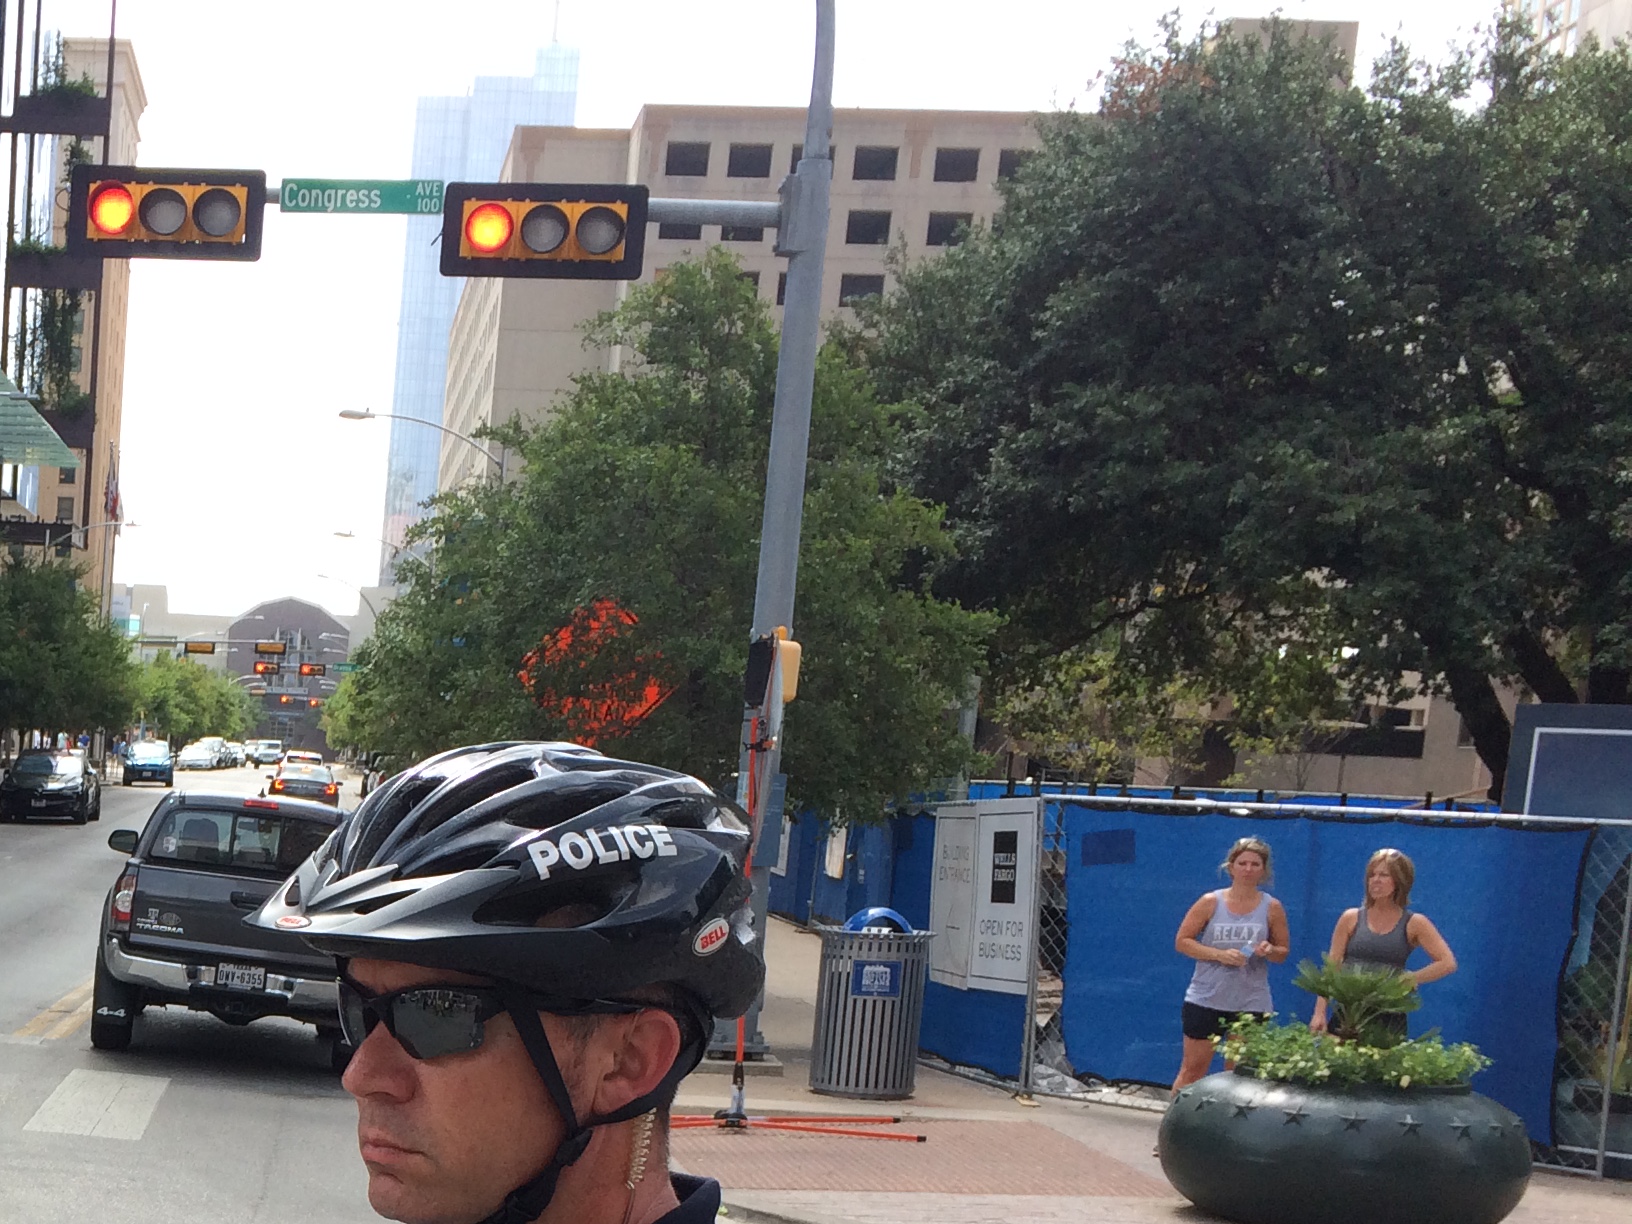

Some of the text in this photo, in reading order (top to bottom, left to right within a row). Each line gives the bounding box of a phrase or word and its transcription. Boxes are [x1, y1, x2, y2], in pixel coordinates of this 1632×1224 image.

[415, 181, 440, 196] AVE
[285, 183, 381, 212] Congress
[418, 198, 439, 211] 100
[526, 825, 678, 880] POLICE
[942, 844, 970, 861] BUILDING
[994, 853, 1016, 866] WELLS
[939, 866, 971, 883] ENTRANCE
[994, 869, 1015, 882] FARGO
[136, 922, 184, 935] TACOMA
[979, 919, 1024, 938] OPEN FOR
[1214, 926, 1261, 941] RELAX
[700, 925, 728, 950] BELL
[978, 942, 1022, 962] BUSINESS
